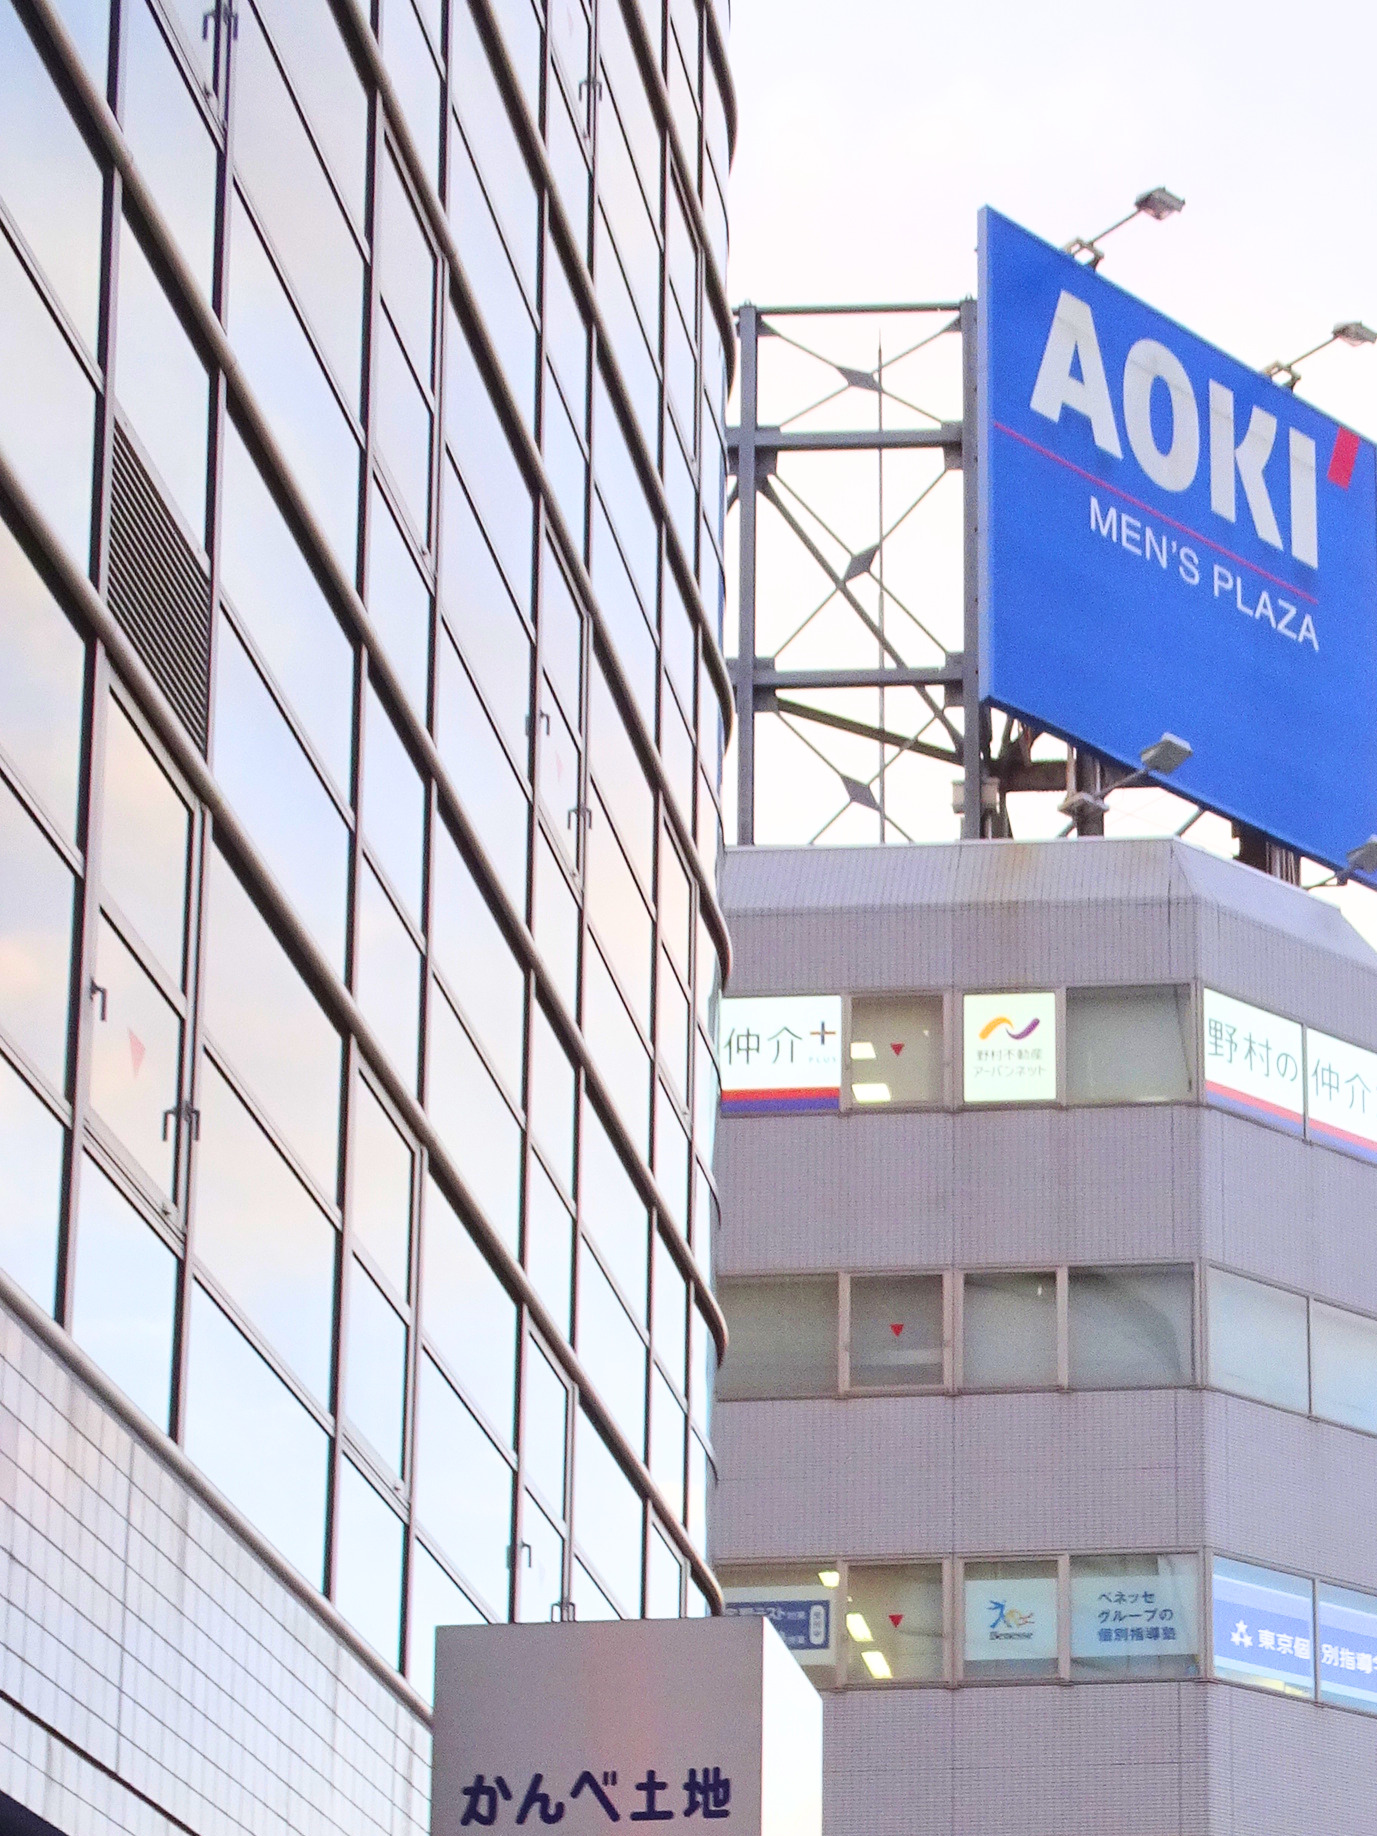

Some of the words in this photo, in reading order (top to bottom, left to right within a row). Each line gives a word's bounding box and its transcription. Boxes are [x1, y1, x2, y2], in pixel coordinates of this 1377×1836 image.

[1030, 290, 1319, 570] AOKI
[1090, 495, 1200, 585] MEN'S
[1213, 564, 1320, 652] PLAZA
[976, 1048, 1043, 1061] 野村不動産
[1098, 1590, 1156, 1605] ベネッセ
[1097, 1608, 1174, 1624] グループの
[1097, 1626, 1177, 1643] 個別指導塾
[460, 1765, 731, 1827] かんべ土地
